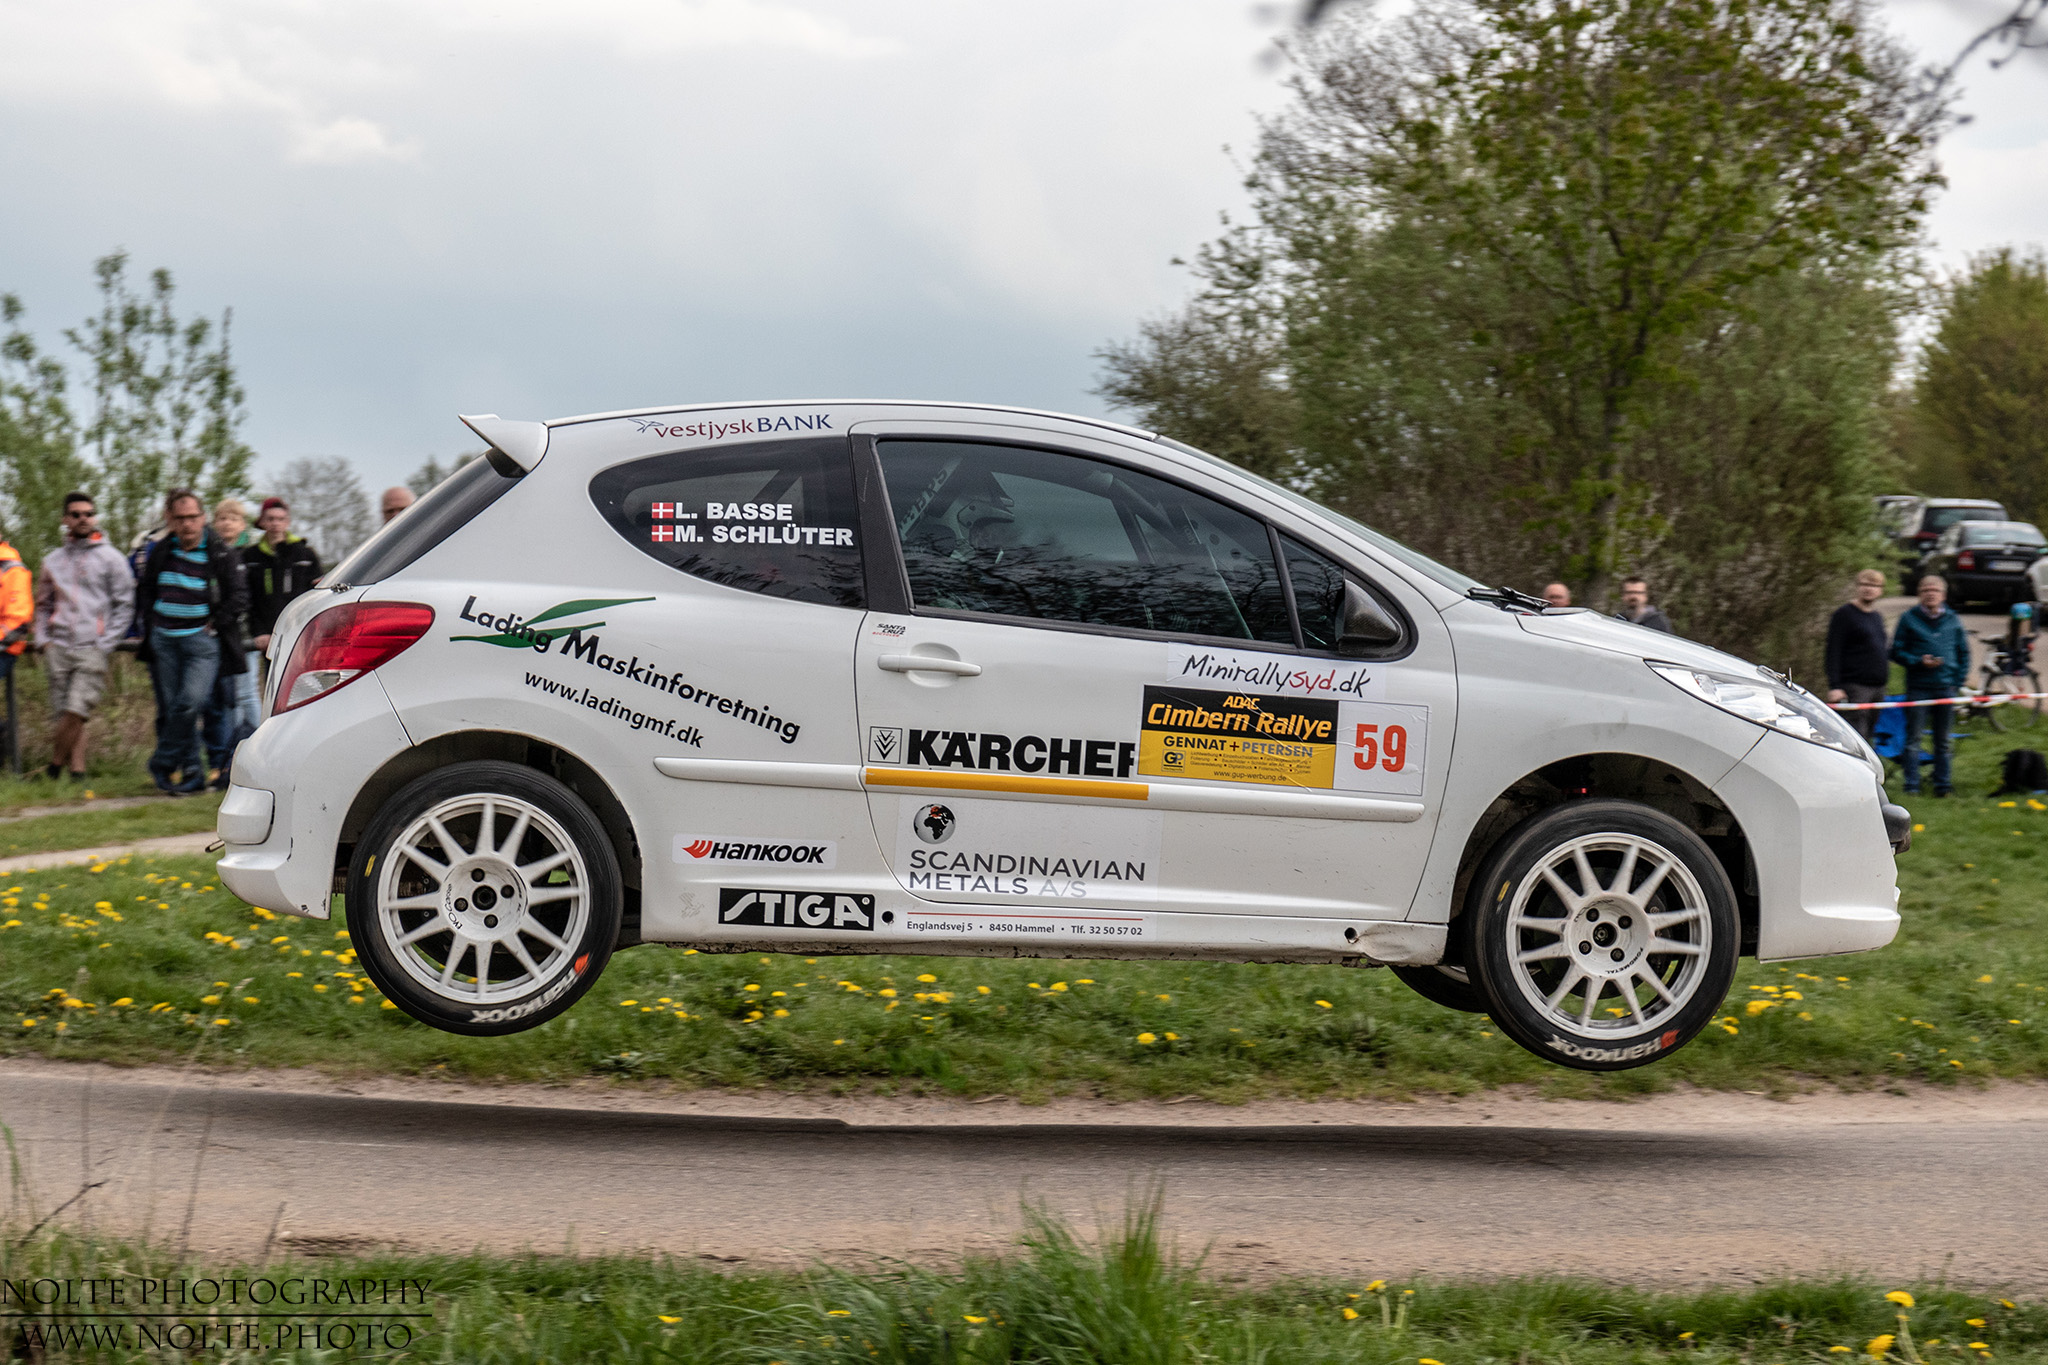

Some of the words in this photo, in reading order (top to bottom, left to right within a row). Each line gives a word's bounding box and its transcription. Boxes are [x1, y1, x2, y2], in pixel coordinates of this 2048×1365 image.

[675, 502, 698, 520] L.
[707, 503, 792, 521] BASSE
[675, 525, 703, 543] M.
[712, 524, 853, 546] SCHLÜTER
[877, 623, 906, 631] SANTA
[459, 595, 553, 654] Lading
[560, 628, 801, 744] Maskinforretning
[1182, 654, 1371, 698] Minirallysyd.dk
[524, 671, 704, 748] www.ladingmf.dk
[1223, 695, 1260, 710] ADAC
[1147, 703, 1249, 731] Cimbern
[1255, 712, 1332, 741] Rallye
[1163, 735, 1227, 751] GENNAT
[1242, 741, 1313, 758] PETERSEN
[1354, 723, 1407, 772] 59
[1213, 770, 1287, 783] www.gup-werbung.de
[910, 850, 1145, 881] SCANDINAVIAN
[909, 871, 1028, 895] METALS
[1038, 879, 1087, 898] A/S
[724, 891, 870, 928] STIGA
[907, 921, 965, 932] Englandsvej
[967, 923, 973, 931] 5
[989, 923, 1013, 932] 8450
[1015, 923, 1055, 933] Hammel
[1071, 925, 1086, 934] Tlf.
[1089, 926, 1101, 934] 32
[1103, 926, 1115, 935] 50
[1117, 926, 1128, 935] 57
[1130, 927, 1143, 936] 02
